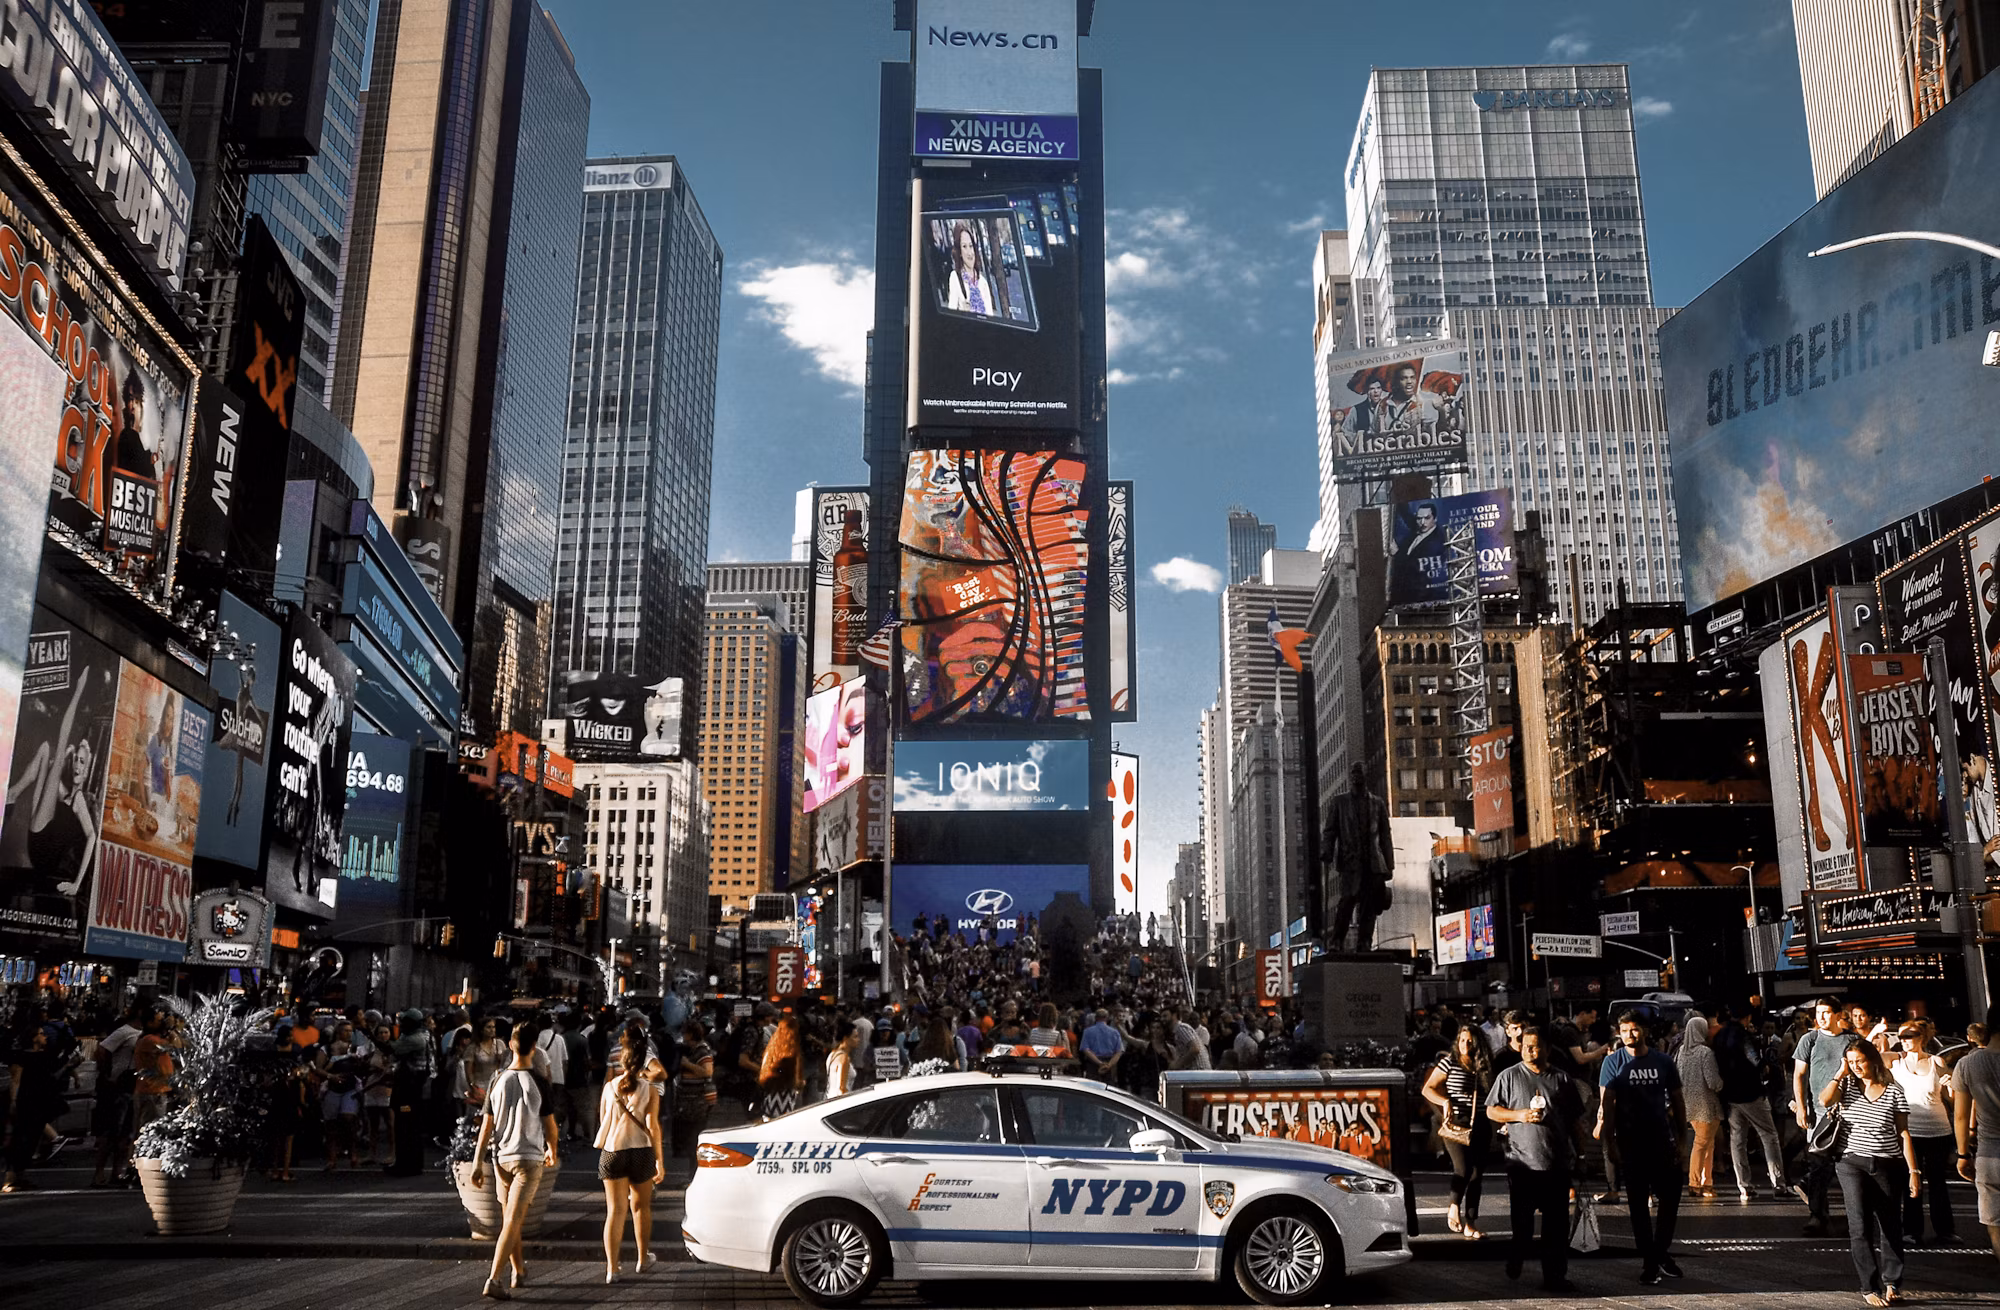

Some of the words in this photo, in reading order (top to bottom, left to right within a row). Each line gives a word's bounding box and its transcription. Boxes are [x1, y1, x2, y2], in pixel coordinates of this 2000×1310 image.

[928, 26, 1058, 50] News.cn
[250, 91, 294, 107] NYC
[1501, 89, 1617, 108] BARCLAYS
[950, 119, 1045, 139] XINHUA
[103, 76, 152, 168] HEATHER
[152, 147, 191, 226] HEADLEY
[928, 138, 983, 153] NEWS
[987, 139, 1065, 154] AGENCY
[98, 120, 187, 291] PURPLE
[61, 236, 92, 283] ANDREW
[92, 270, 113, 304] LLOYD
[112, 296, 138, 335] WEBBER
[41, 237, 61, 273] THE
[61, 259, 116, 335] EMPOWERING
[115, 325, 150, 373] MESSAGE
[149, 360, 160, 383] OF
[0, 223, 112, 426] SCHOOL
[1329, 361, 1353, 373] FINAL
[972, 368, 1023, 392] Play
[923, 399, 945, 408] Watch
[945, 400, 986, 408] Unbreakable
[987, 401, 1009, 410] Kimmy
[1010, 401, 1037, 409] Schmidt
[1047, 402, 1068, 410] Netflix
[1379, 416, 1410, 434] Les
[1335, 421, 1463, 458] Misérables
[211, 402, 240, 517] NEW
[1391, 452, 1421, 461] IMPERIAL
[1422, 450, 1452, 458] THEATRE
[112, 478, 156, 517] BEST
[1450, 508, 1468, 517] LET
[1471, 503, 1499, 514] YOUR
[110, 508, 154, 536] MUSICAL!
[1418, 546, 1512, 571] PHOM
[1902, 557, 1945, 602] Winner!
[960, 585, 980, 600] day
[1904, 600, 1912, 619] 4
[1912, 596, 1925, 611] TONY
[1924, 587, 1943, 606] AWARDS
[1900, 618, 1921, 645] Best
[1921, 599, 1958, 631] Musical!
[29, 638, 68, 665] YEARS
[291, 638, 307, 671] Go
[307, 655, 335, 700] where
[288, 680, 313, 718] your
[1860, 683, 1925, 725] JERSEY
[182, 709, 207, 741] BEST
[284, 721, 318, 766] routine
[1870, 719, 1921, 757] BOYS
[280, 761, 309, 800] can't.
[939, 761, 1041, 792] IONIQ
[1033, 796, 1056, 804] SHOW
[1813, 857, 1834, 874] WINNER!
[1837, 853, 1850, 869] TONY
[1815, 869, 1836, 882] INCLUDING
[1836, 867, 1848, 878] BEST
[98, 841, 191, 942] WAITRESS
[958, 918, 1018, 930] HYDA
[1841, 902, 1875, 927] American
[206, 944, 248, 960] Sanrio
[1535, 936, 1565, 945] PEDESTRIAN
[1565, 937, 1579, 946] FLOW
[1560, 946, 1573, 954] KEEP
[1574, 947, 1593, 955] MOVING
[776, 950, 797, 994] tkts
[1628, 1068, 1660, 1081] ANU
[1629, 1078, 1661, 1086] SPORT
[755, 1141, 860, 1160] TRAFFIC
[791, 1161, 810, 1175] SPL
[813, 1161, 833, 1175] OPS
[1041, 1178, 1187, 1218] NYPD
